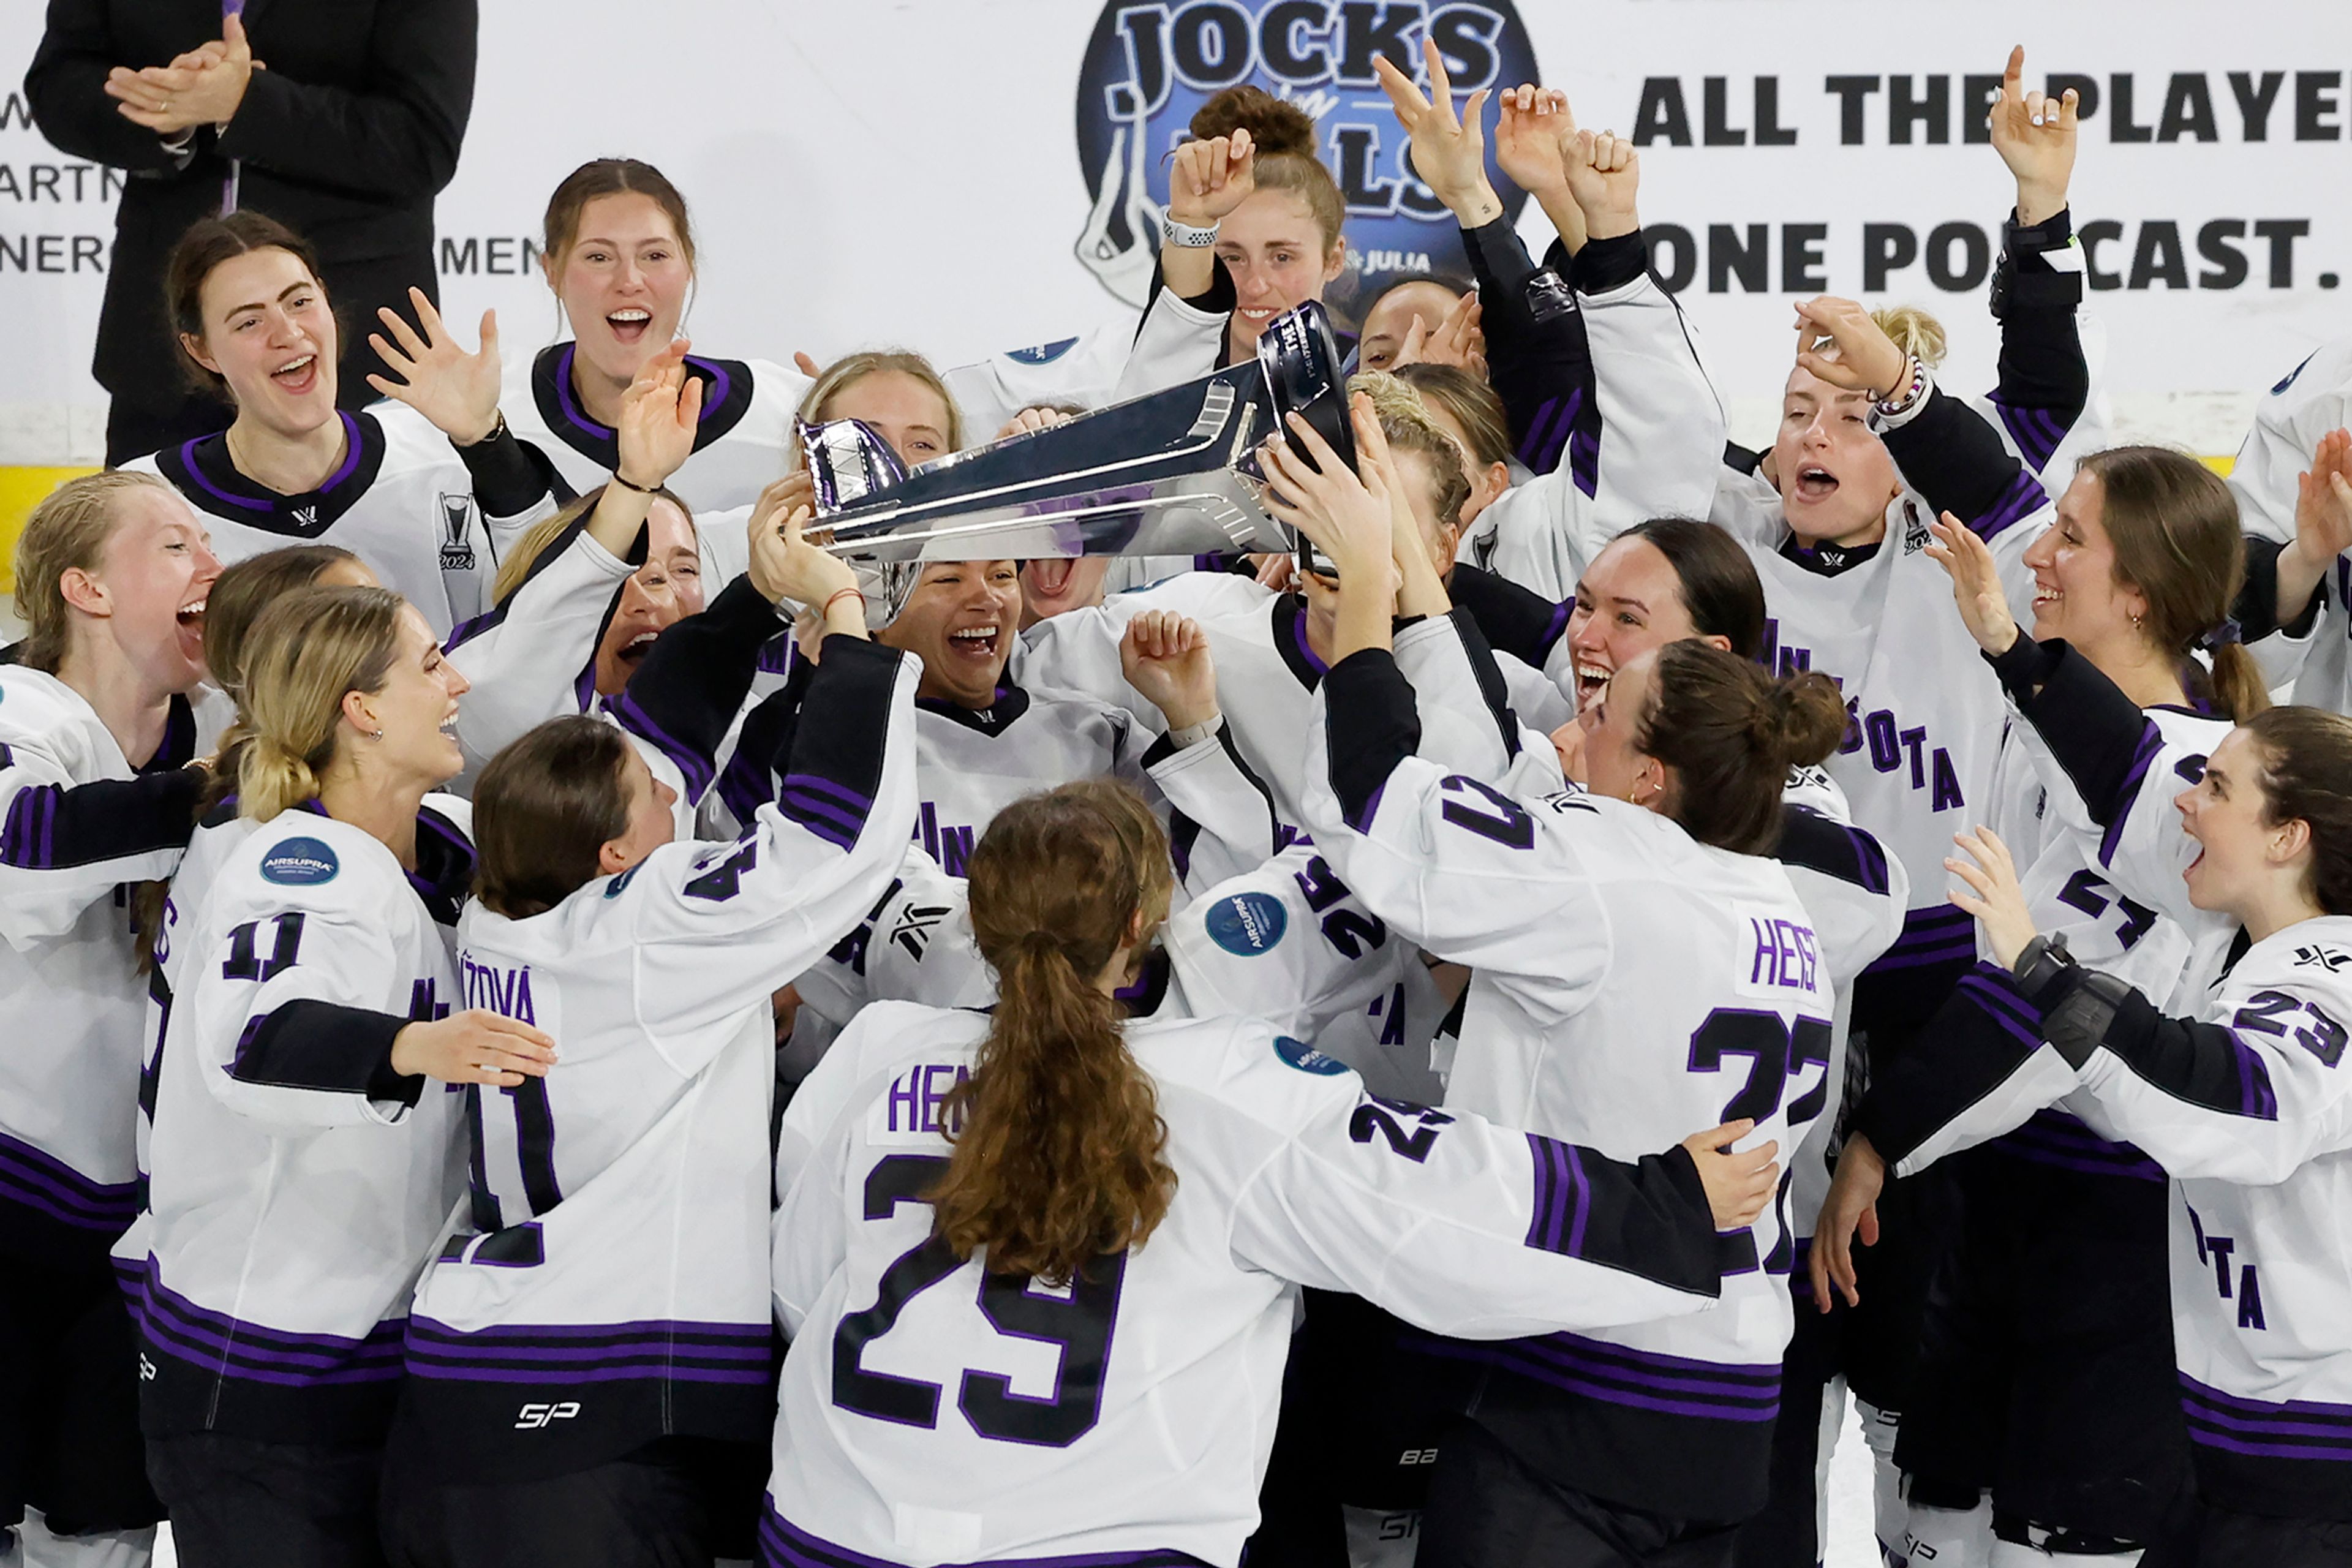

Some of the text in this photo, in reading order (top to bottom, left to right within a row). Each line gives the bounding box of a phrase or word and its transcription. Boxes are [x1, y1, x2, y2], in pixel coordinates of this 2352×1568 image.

[1098, 0, 1506, 121] JOCKS
[1632, 70, 2352, 147] ALL THE PLAYE
[1363, 250, 1431, 276] JULIA
[1640, 219, 2340, 293] ONE POCAST.
[439, 554, 475, 570] 2024
[1231, 897, 1264, 948] AIRSUPRA
[2233, 990, 2350, 1069] 23
[832, 1155, 1129, 1449] 29
